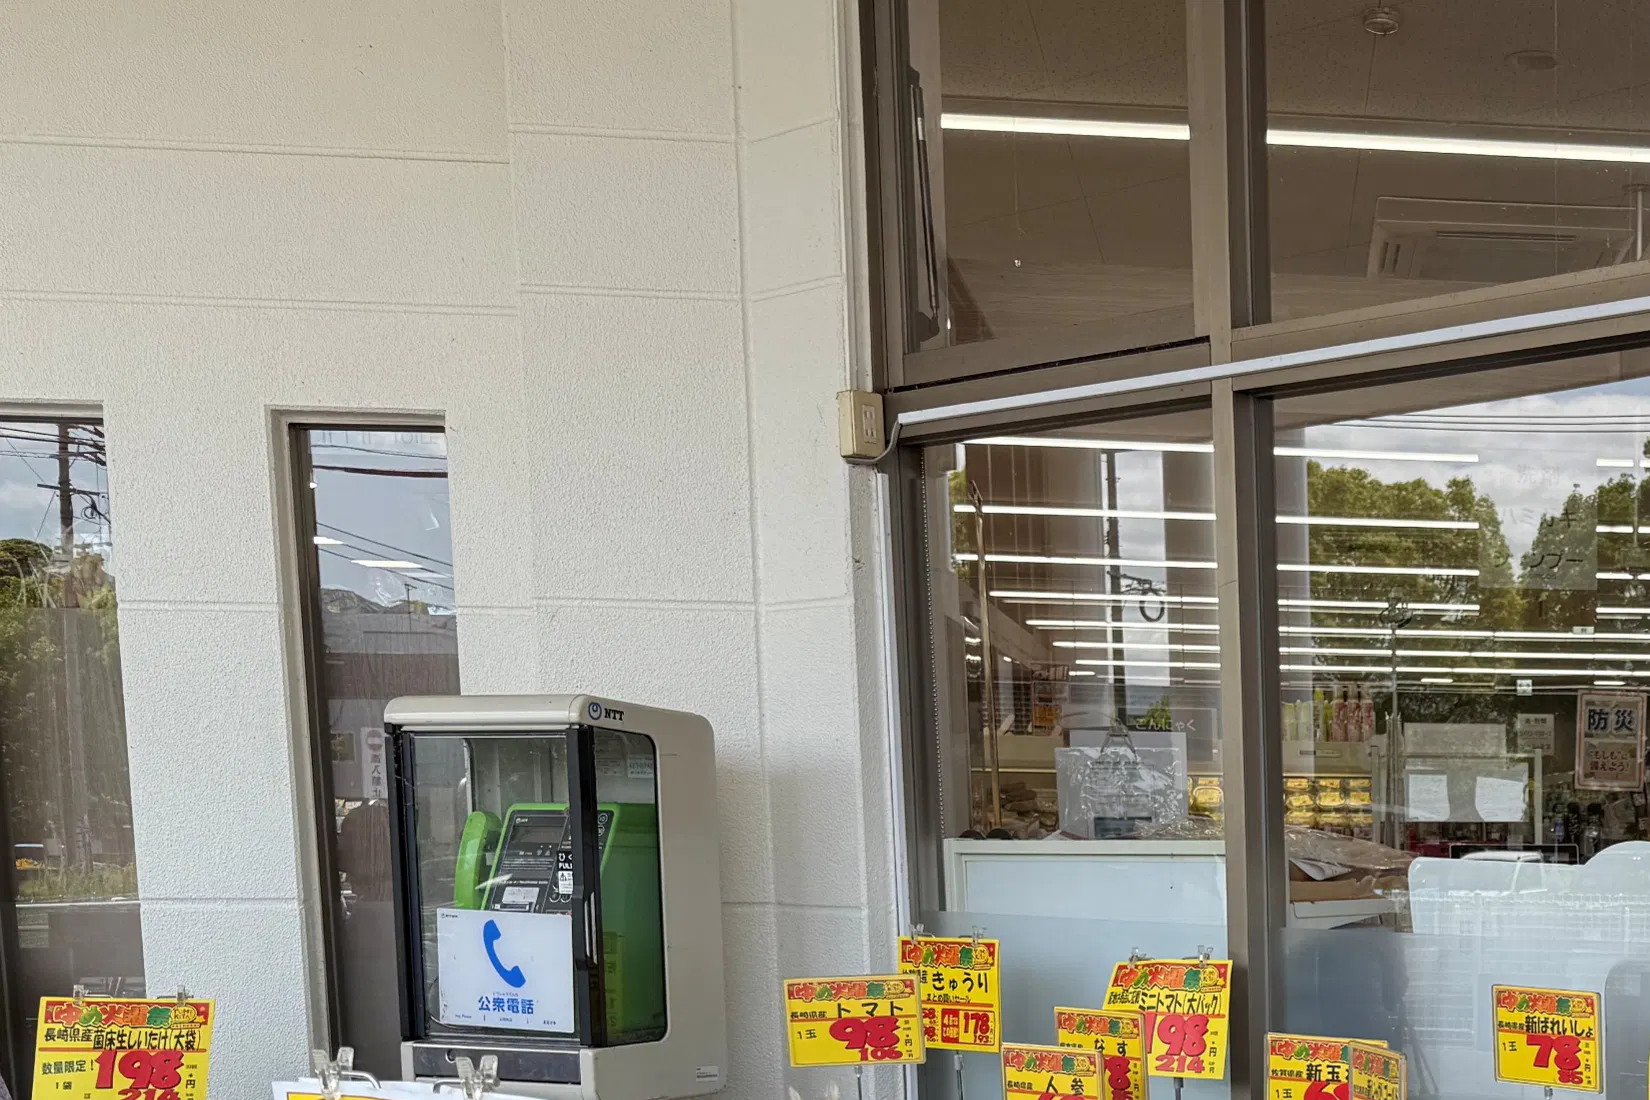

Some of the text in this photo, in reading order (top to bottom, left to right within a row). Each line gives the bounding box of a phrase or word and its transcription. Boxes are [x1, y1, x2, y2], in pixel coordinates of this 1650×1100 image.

[604, 708, 625, 721] NTT
[1587, 708, 1634, 732] 防災
[932, 971, 988, 993] きゅうり
[478, 996, 534, 1014] 公衆電話
[837, 1001, 903, 1018] トマト
[829, 1017, 902, 1049] 98
[963, 1012, 990, 1035] 178
[1525, 1015, 1593, 1038] 新ばれいしょ
[44, 1028, 92, 1042] 長崎県産
[1094, 1038, 1128, 1056] なす
[1526, 1034, 1582, 1070] 78
[95, 1050, 184, 1089] 198
[1104, 1057, 1130, 1090] 8
[1155, 1055, 1205, 1074] 214
[1306, 1063, 1349, 1083] 新玉
[185, 1078, 196, 1089] 円
[1046, 1076, 1084, 1095] 人参
